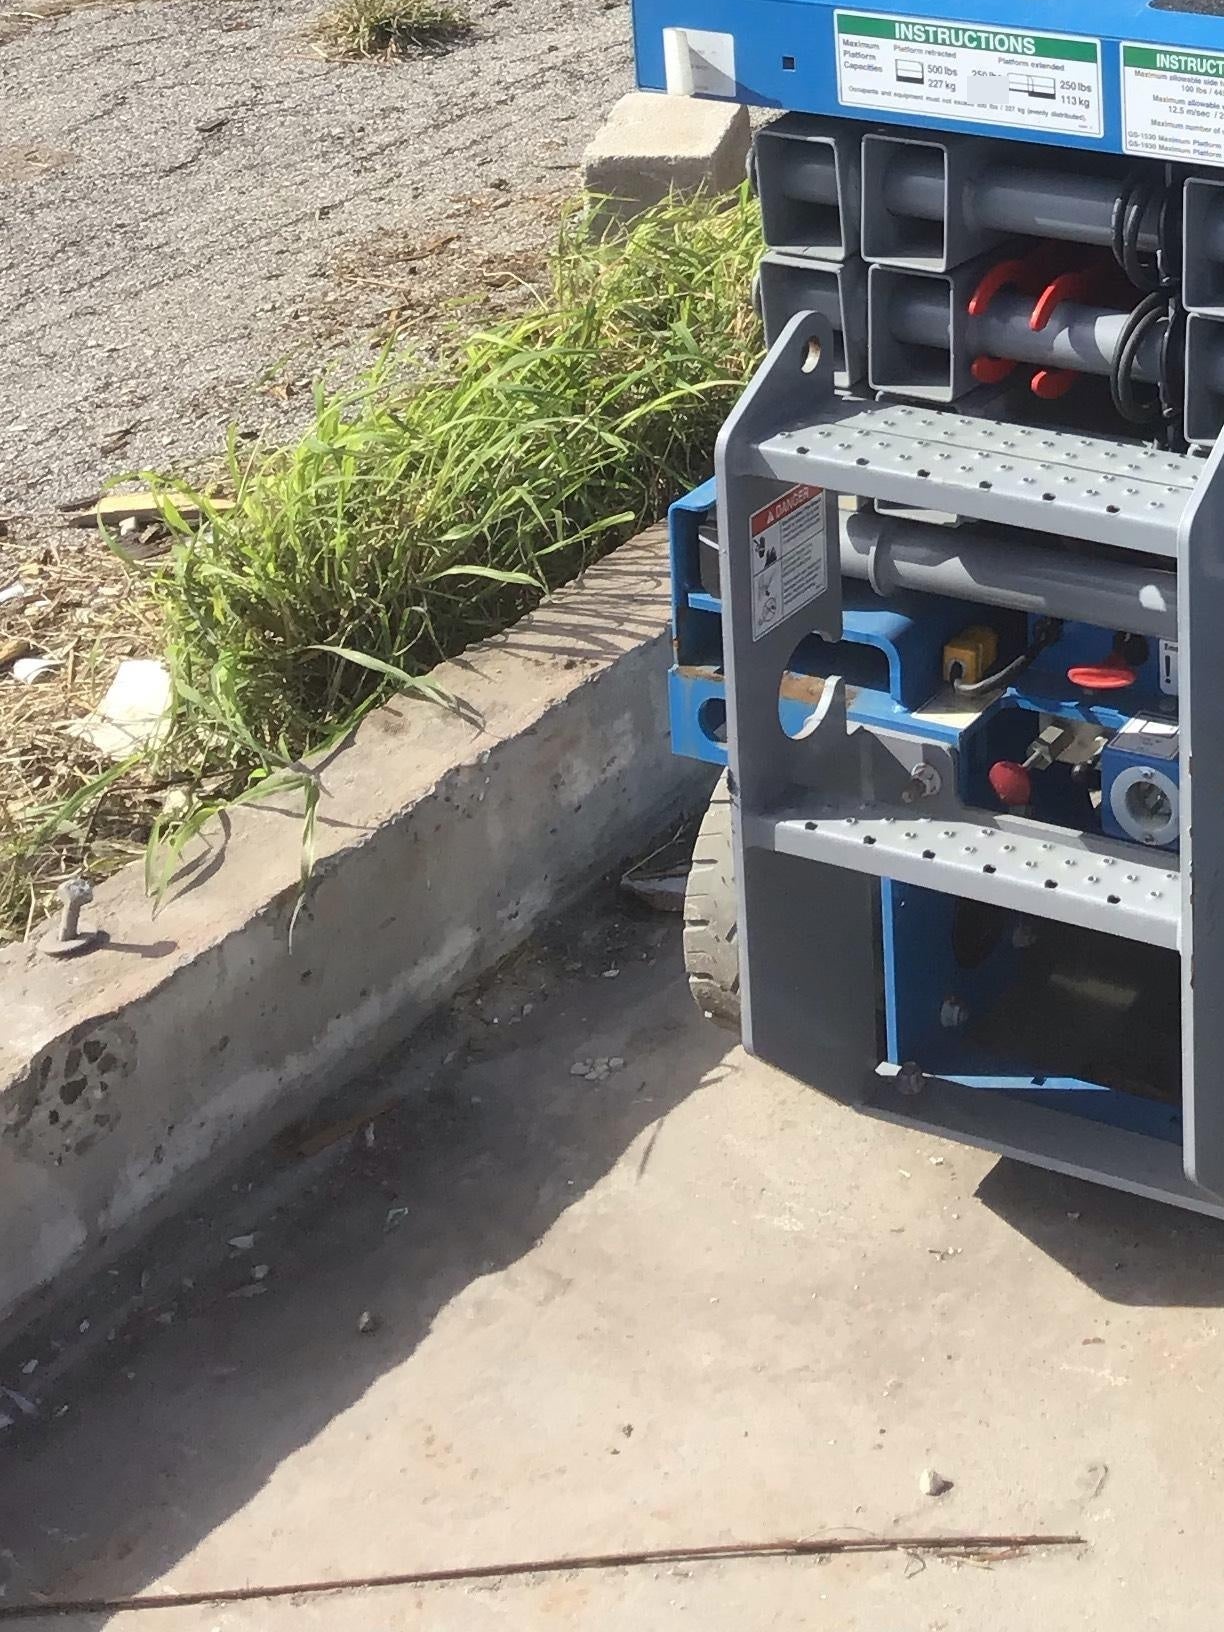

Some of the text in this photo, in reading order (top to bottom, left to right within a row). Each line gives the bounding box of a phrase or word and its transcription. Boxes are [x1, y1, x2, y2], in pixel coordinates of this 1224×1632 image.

[842, 38, 879, 49] Maximum
[894, 23, 1035, 54] INSTRUCTIONS
[843, 49, 876, 60] Platform
[927, 64, 958, 76] 500 lbs
[1134, 70, 1167, 80] Maximum
[928, 79, 956, 92] 227 kg
[1060, 80, 1092, 92] 250 lbs
[1195, 86, 1207, 94] lbs
[1061, 95, 1090, 109] 113 kg
[1152, 94, 1185, 105] Maximum
[1168, 106, 1184, 115] 12.5
[1186, 109, 1210, 118] m/sec
[1151, 119, 1183, 129] Maximum
[775, 487, 809, 519] DANGER
